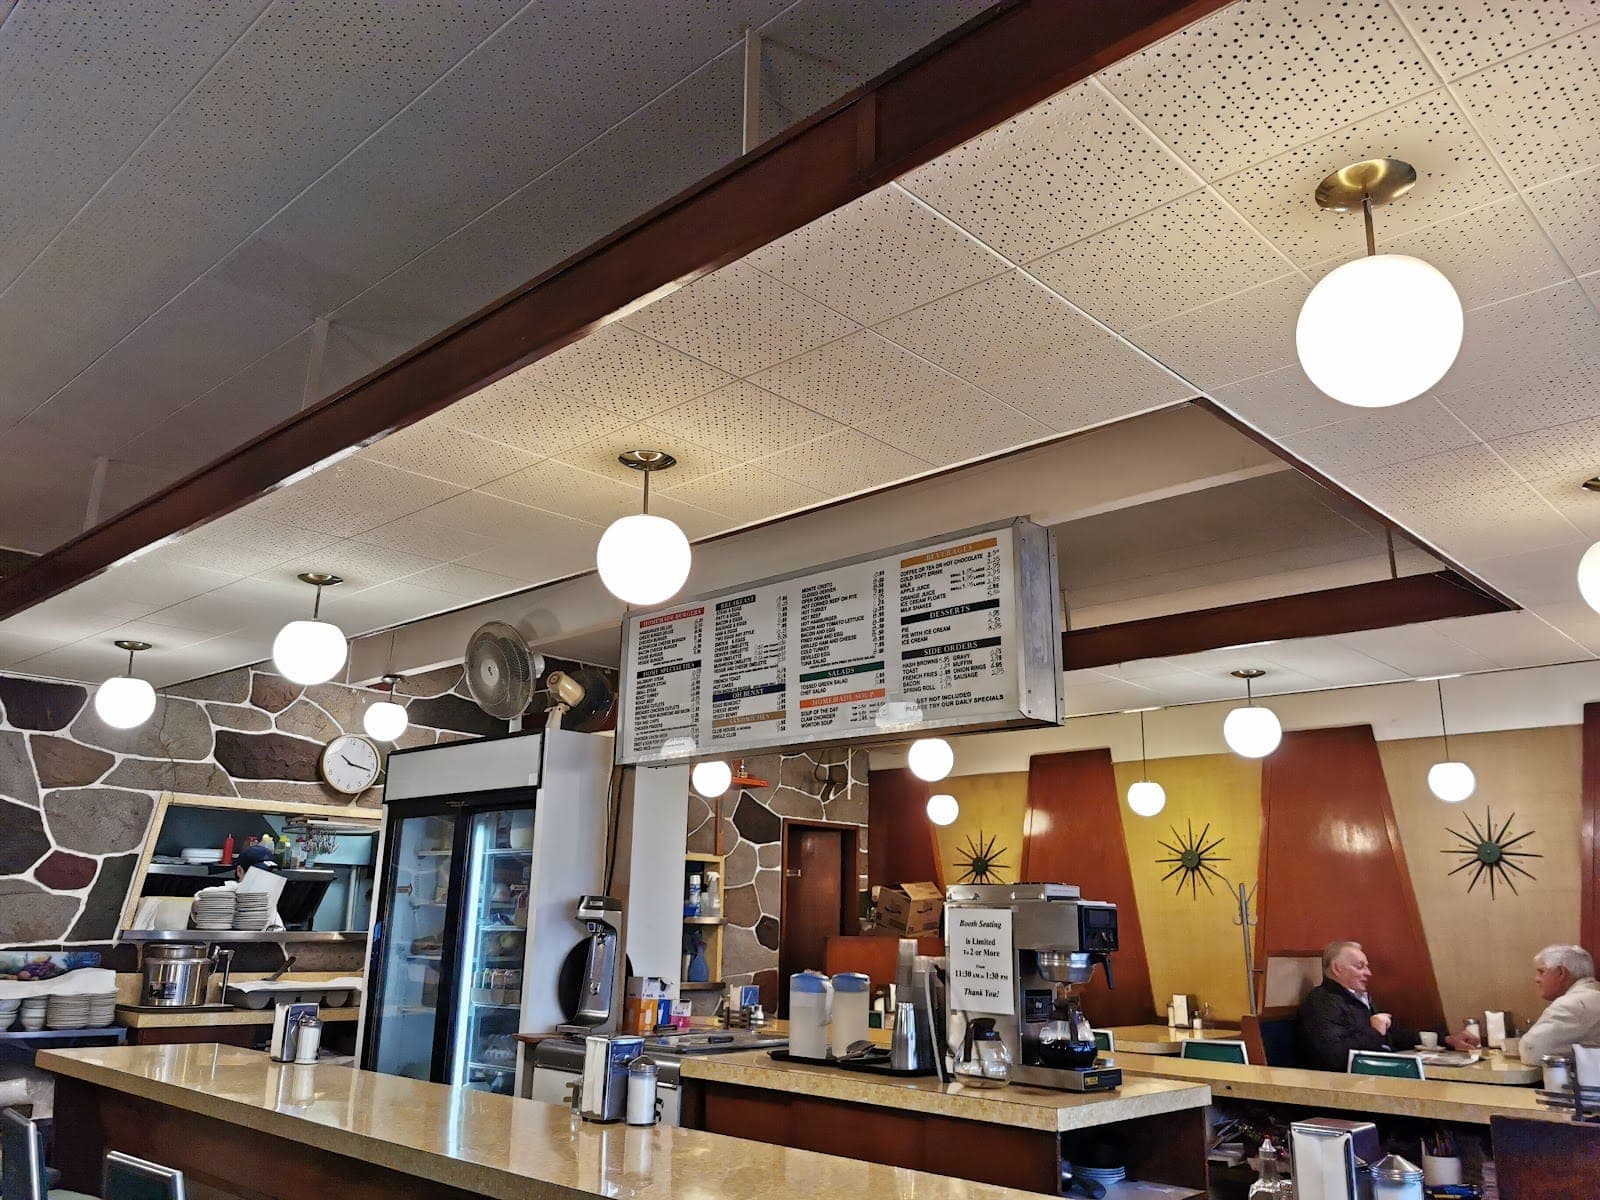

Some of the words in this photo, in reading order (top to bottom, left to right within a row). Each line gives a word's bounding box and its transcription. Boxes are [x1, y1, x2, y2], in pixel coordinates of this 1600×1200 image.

[926, 544, 973, 560] BEVERAGES
[899, 568, 917, 577] COFFEE
[953, 553, 982, 564] CHOCOLATE
[900, 592, 919, 601] ORANGE
[927, 593, 945, 601] FLOATS
[720, 595, 753, 609] BREAKFAST
[675, 608, 701, 619] BURGERS
[929, 604, 970, 618] DESSERTS
[810, 615, 836, 624] HAMBURGER
[844, 615, 863, 623] LETTUCE
[924, 646, 942, 655] SIDE
[944, 641, 977, 652] ORDERS
[828, 666, 854, 676] SALADS
[953, 672, 977, 680] SAUSAGE
[743, 688, 763, 696] BENNY
[942, 692, 971, 700] INCLUDED
[813, 694, 851, 705] HOMEMADE
[974, 694, 1004, 703] SPECIALS
[978, 920, 1002, 929] Seating
[955, 970, 971, 978] 11:30
[964, 988, 982, 997] Thank
[985, 988, 999, 998] You!
